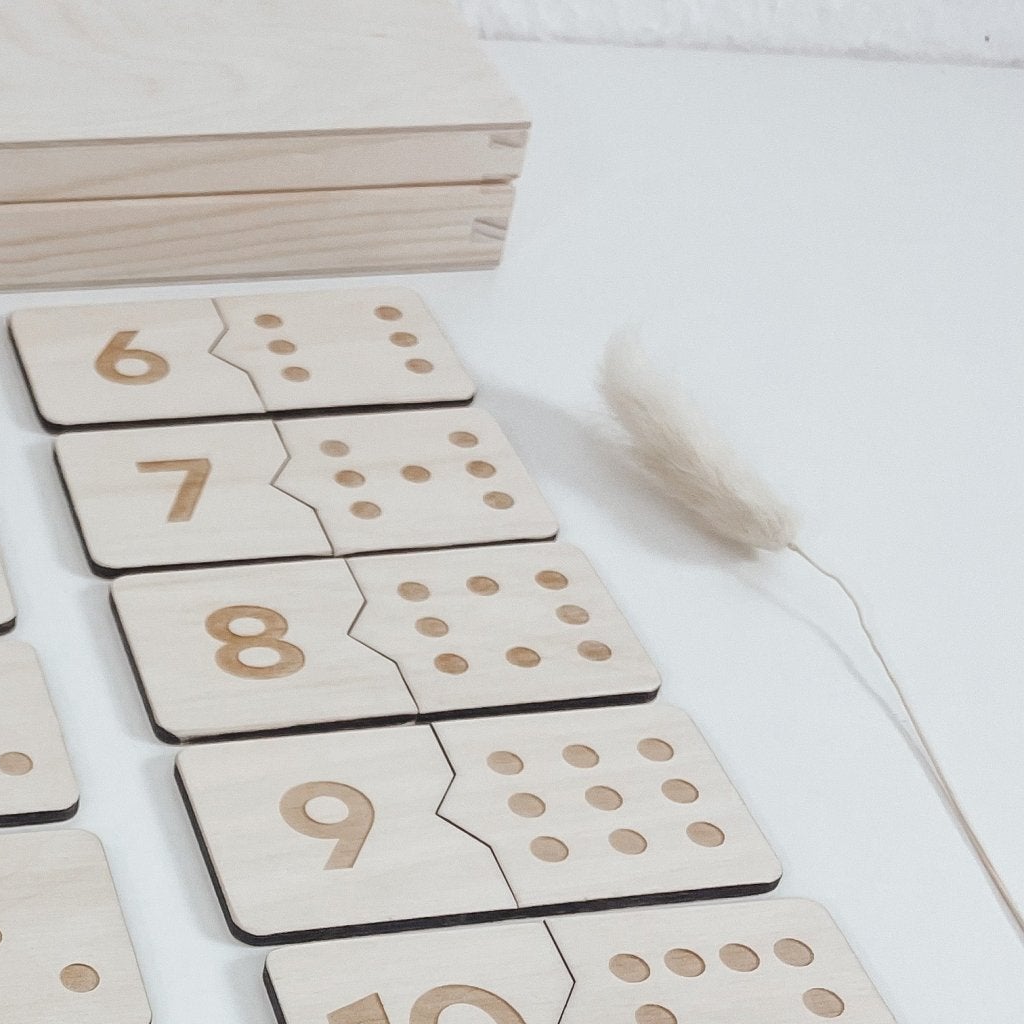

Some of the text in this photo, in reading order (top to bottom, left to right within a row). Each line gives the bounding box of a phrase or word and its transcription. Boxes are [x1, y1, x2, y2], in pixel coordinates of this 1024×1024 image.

[95, 330, 168, 383] 6
[138, 458, 211, 521] 7
[206, 604, 304, 678] 8
[279, 781, 376, 869] 9
